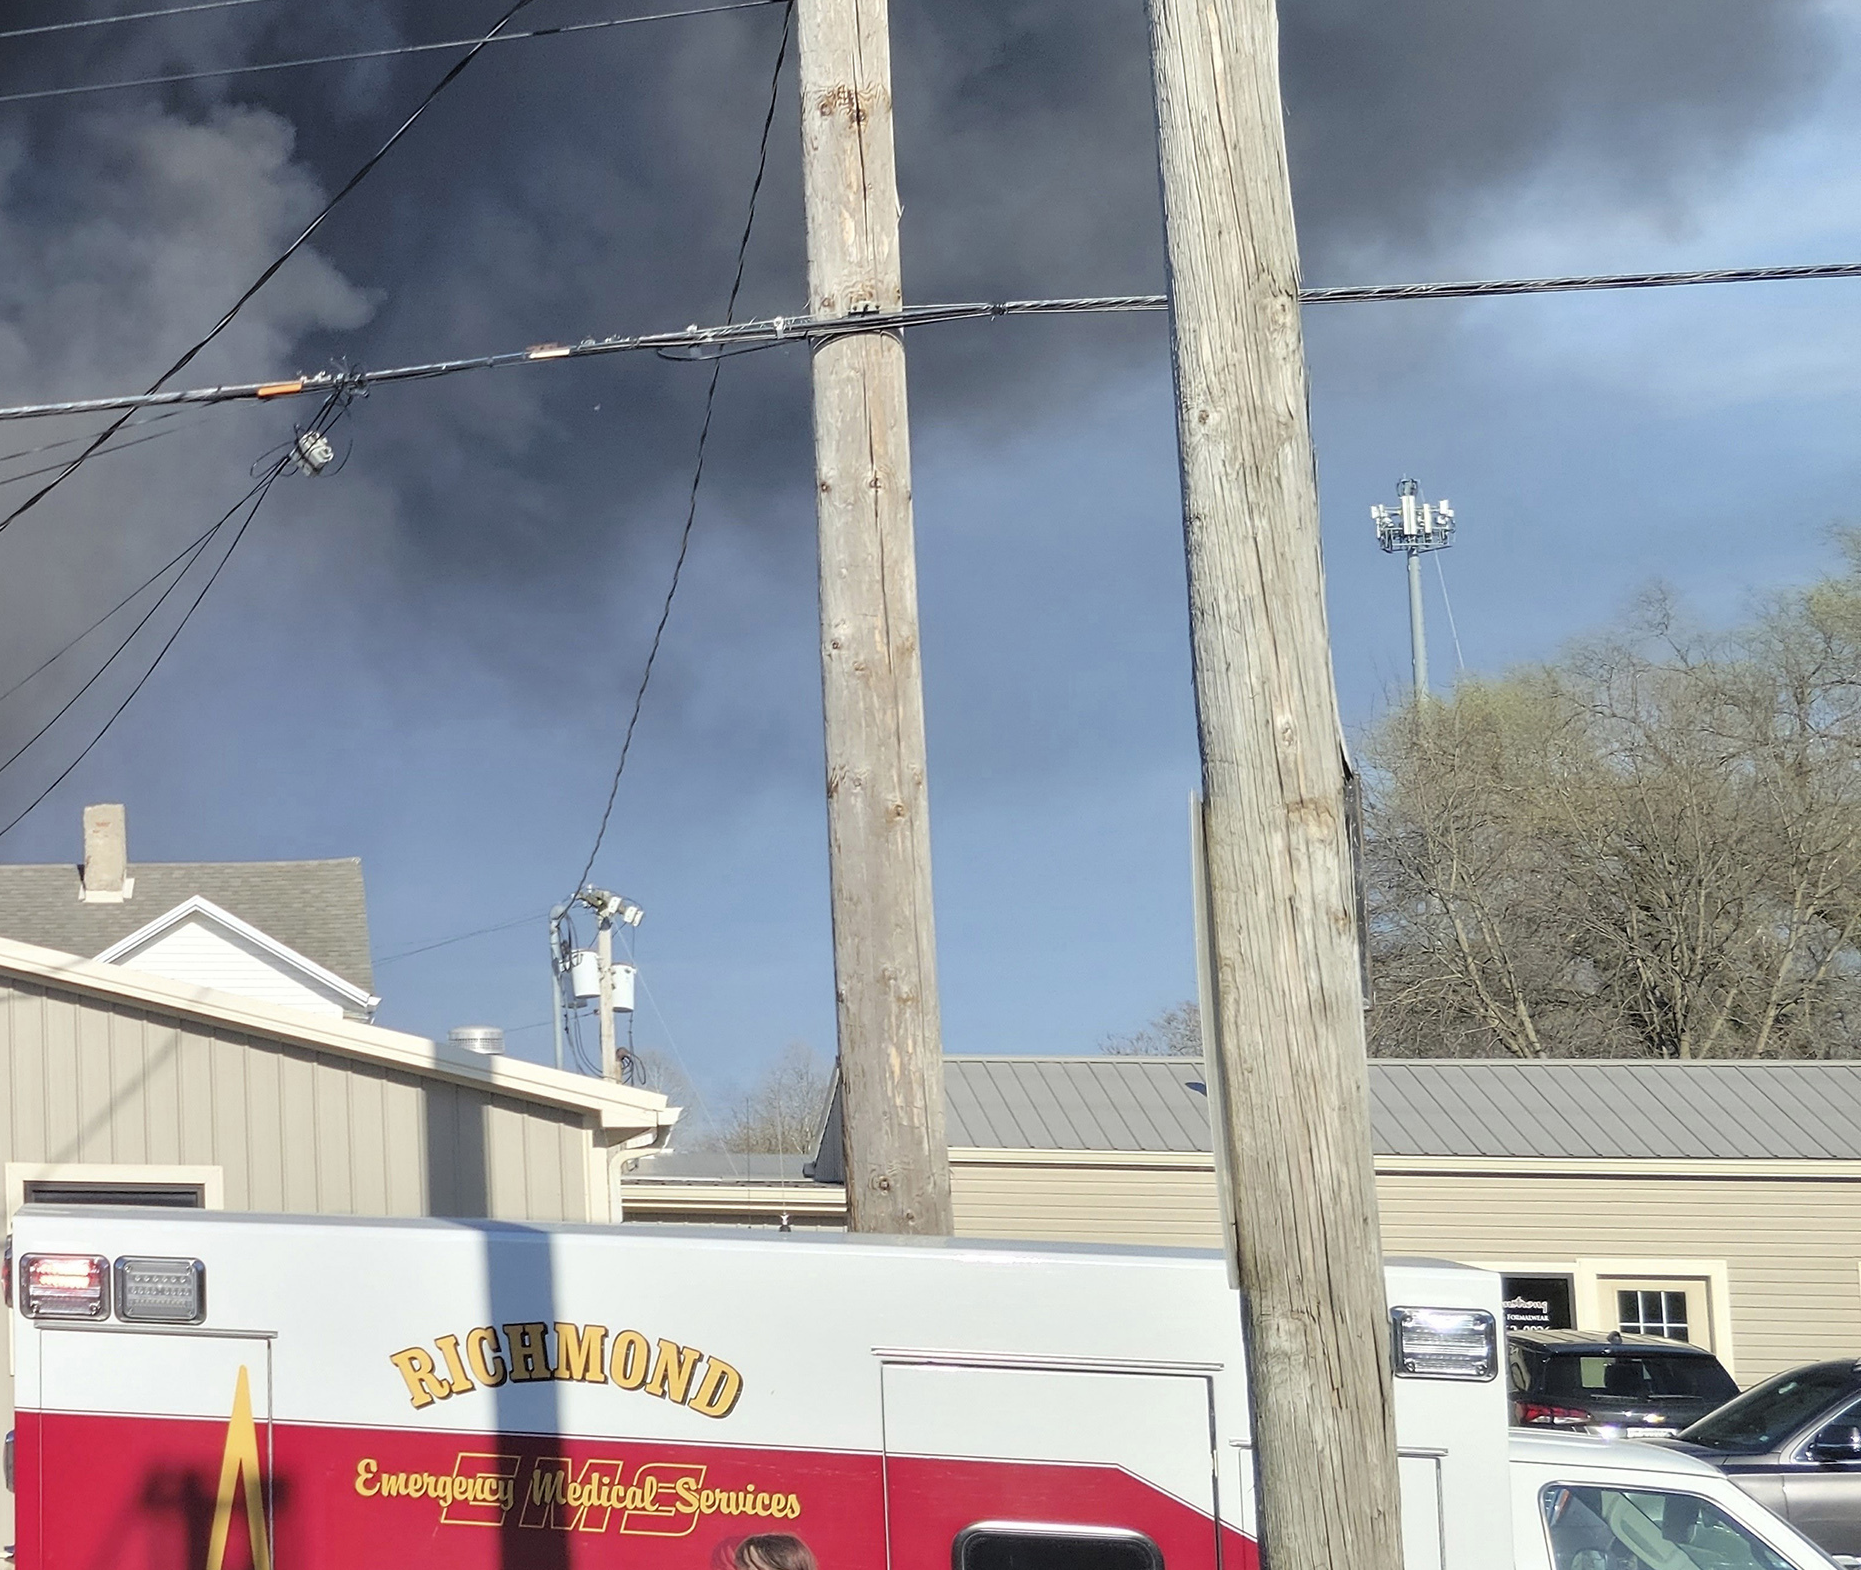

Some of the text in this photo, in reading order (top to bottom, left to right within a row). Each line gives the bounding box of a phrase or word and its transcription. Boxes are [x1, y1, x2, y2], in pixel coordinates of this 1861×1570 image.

[390, 1321, 744, 1418] RICHMOND
[354, 1458, 801, 1519] Emergency Medical Services
[440, 1452, 707, 1536] EMS
